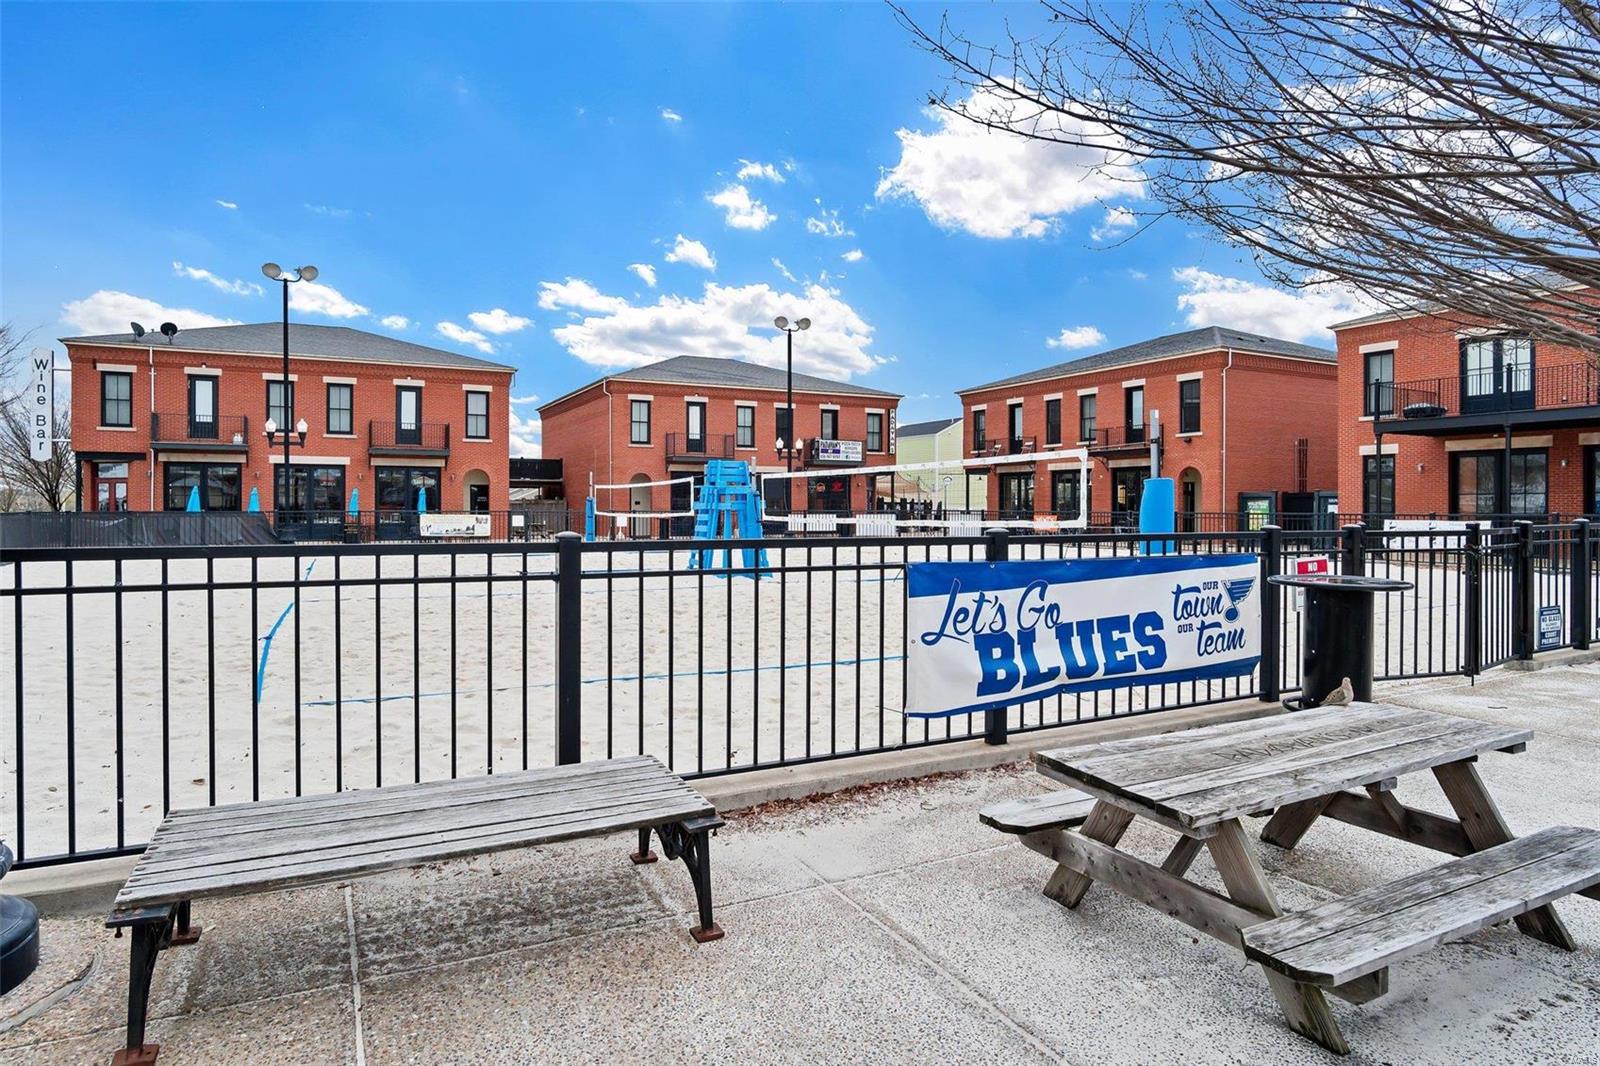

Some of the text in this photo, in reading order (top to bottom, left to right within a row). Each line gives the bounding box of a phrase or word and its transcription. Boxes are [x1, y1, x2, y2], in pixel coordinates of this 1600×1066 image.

[34, 358, 49, 451] Wine Bar
[1307, 562, 1318, 572] NO
[1172, 584, 1223, 621] town
[1202, 581, 1219, 592] OUR
[921, 577, 1064, 647] Let's Go
[1177, 623, 1194, 634] OUR
[975, 611, 1167, 697] BLUES
[1195, 620, 1247, 657] team
